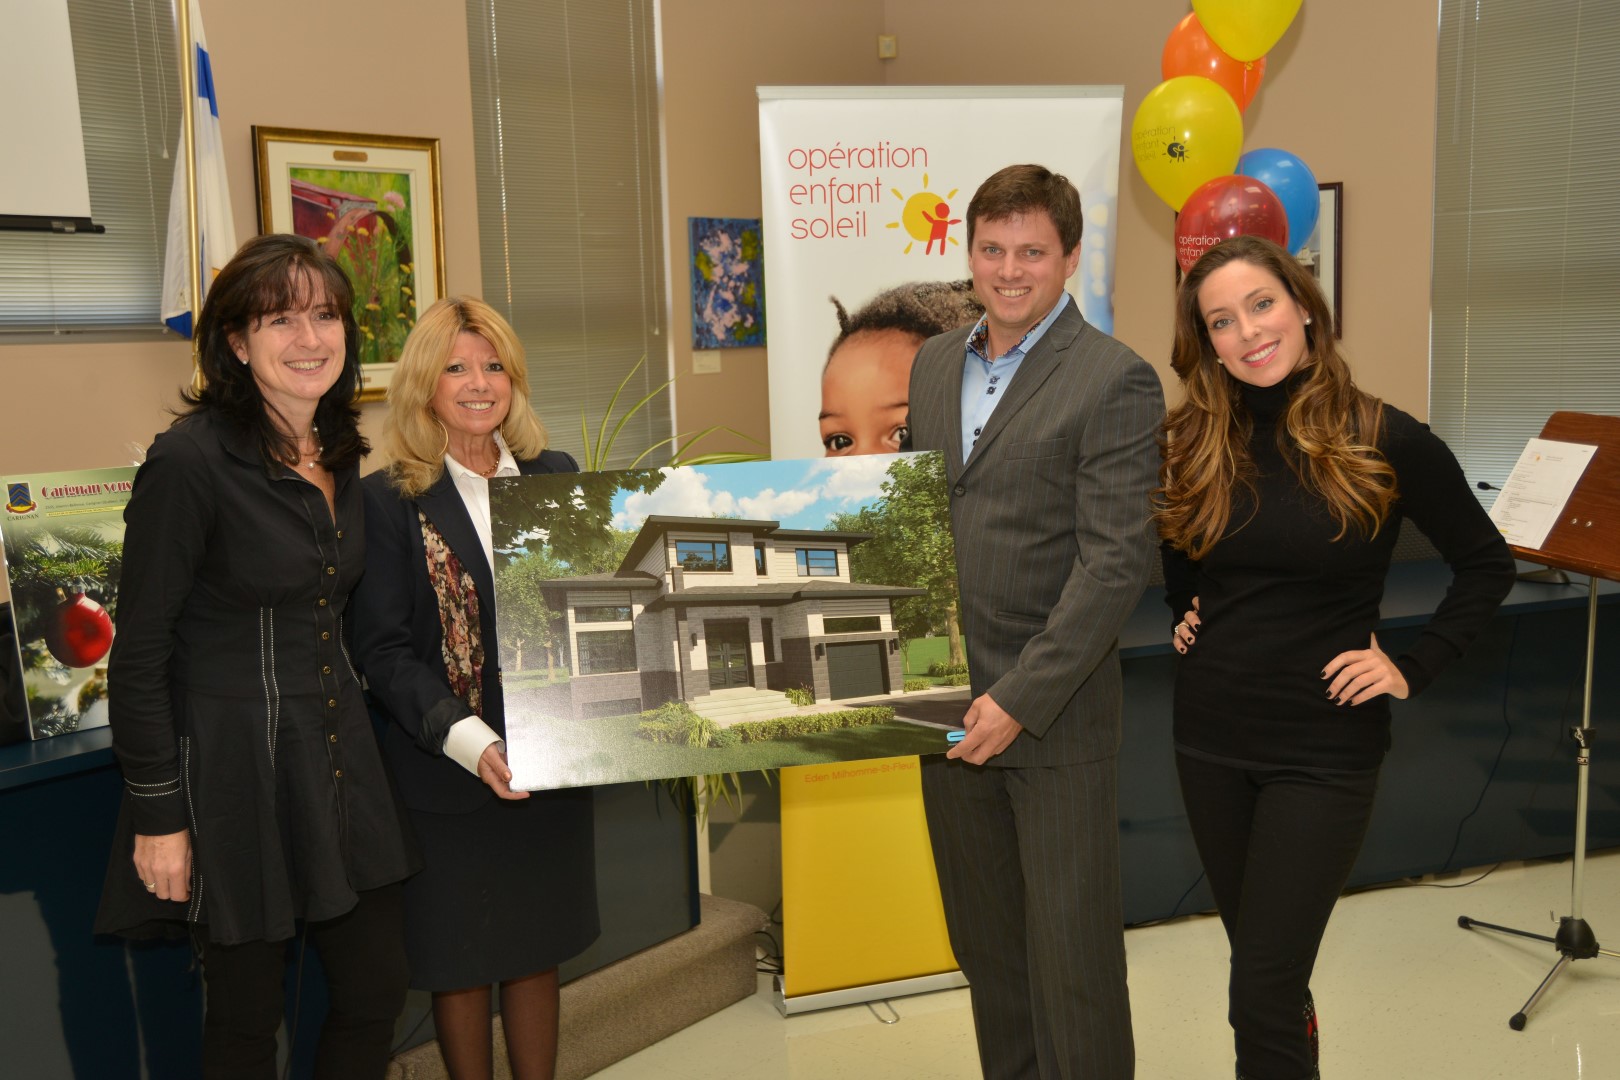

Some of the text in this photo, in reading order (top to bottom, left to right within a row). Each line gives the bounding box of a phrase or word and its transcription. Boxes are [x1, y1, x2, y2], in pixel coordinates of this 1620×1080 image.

[788, 141, 928, 176] opération
[789, 176, 882, 206] enfant
[791, 210, 866, 239] soleil
[1179, 235, 1221, 246] opération
[1180, 246, 1204, 257] enfant
[41, 484, 101, 499] Carignan
[7, 513, 39, 521] CARIGNAN
[804, 773, 830, 783] Eden
